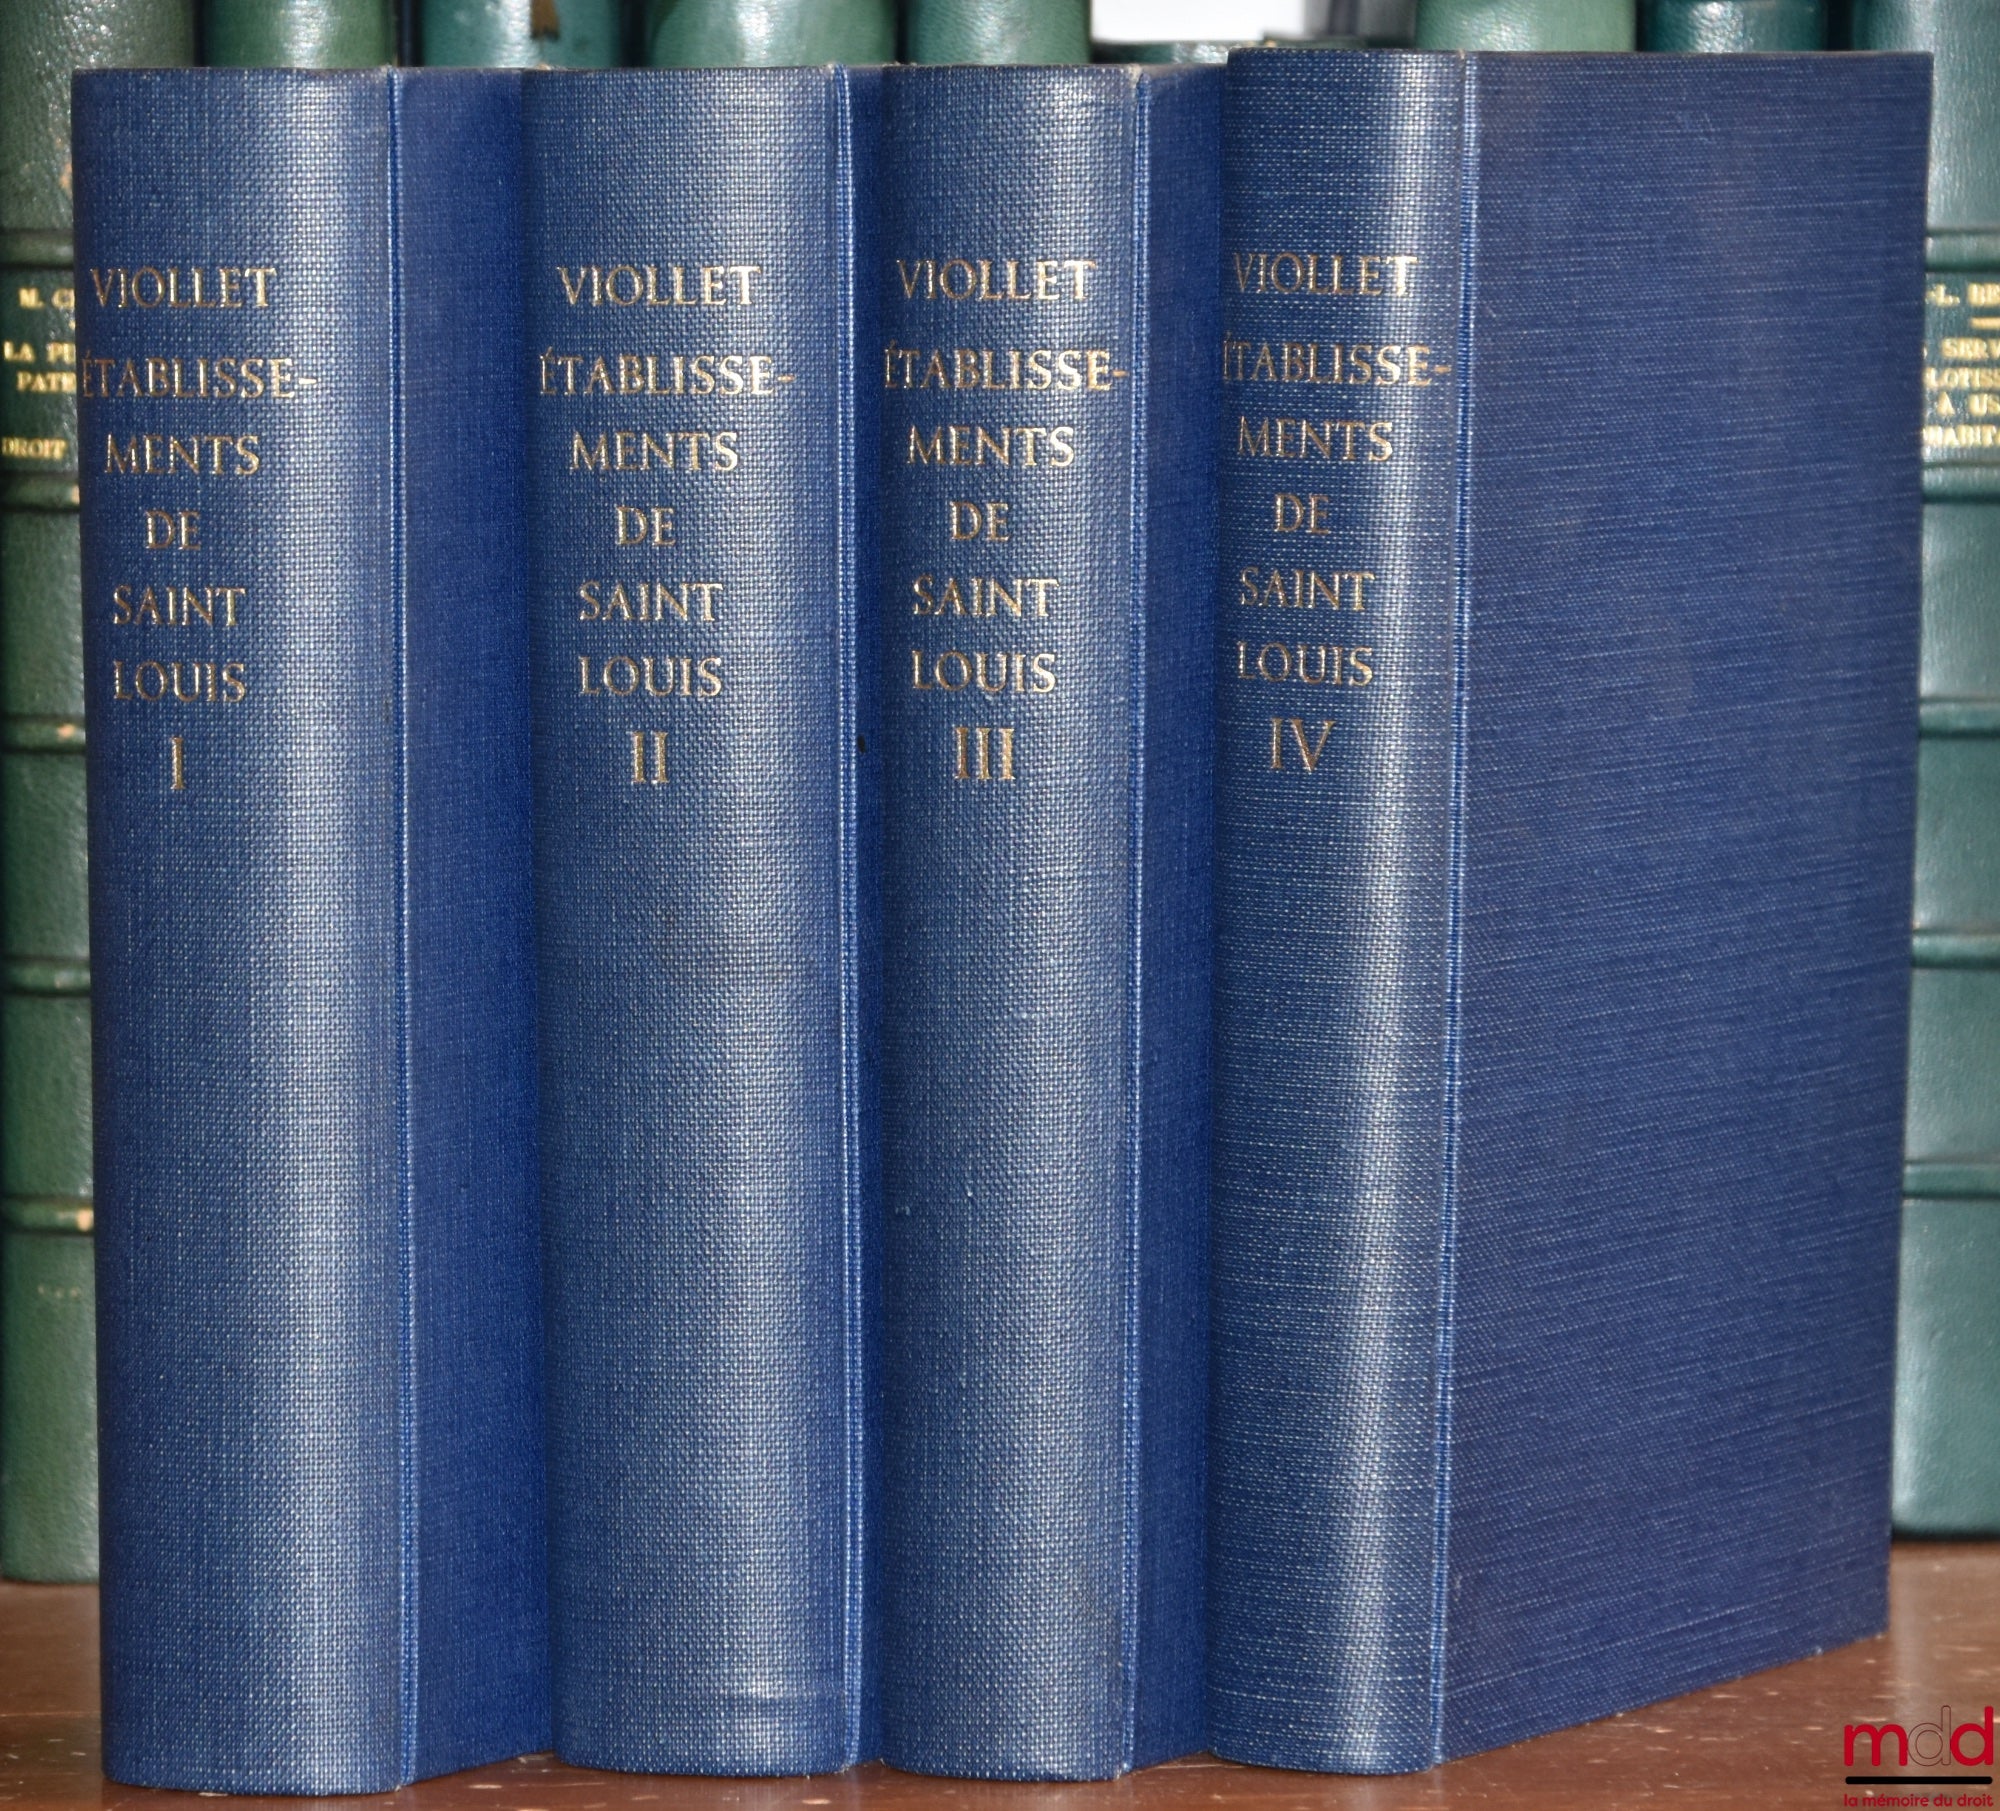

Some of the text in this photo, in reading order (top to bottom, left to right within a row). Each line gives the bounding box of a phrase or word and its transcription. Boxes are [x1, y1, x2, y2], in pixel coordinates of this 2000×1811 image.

[90, 266, 277, 309] VIOLLET
[556, 264, 761, 307] VIOLLET
[896, 258, 1096, 301] VIOLLET
[1234, 252, 1418, 296] VIOLLET
[3, 341, 35, 363] LA
[539, 346, 796, 396] ÉTABLISSE-
[884, 339, 1129, 391] ÉTABLISSE-
[1223, 331, 1452, 387] ÉTABLISSE-
[80, 349, 318, 399] ÉTABLISSE-
[104, 434, 262, 475] MENTS
[569, 430, 739, 473] MENTS
[907, 425, 1075, 468] MENTS
[1238, 415, 1394, 462] MENTS
[145, 509, 201, 550] DE
[615, 505, 675, 546] DE
[950, 500, 1011, 541] DE
[1274, 493, 1330, 534] DE
[112, 584, 246, 626] SAINT
[579, 580, 724, 622] SAINT
[912, 574, 1059, 618] SAINT
[1240, 566, 1375, 611] SAINT
[112, 660, 246, 702] LOUIS
[578, 655, 723, 697] LOUIS
[911, 650, 1057, 693] LOUIS
[1237, 641, 1374, 686] LOUIS
[170, 735, 186, 790] I
[630, 730, 669, 783] II
[954, 726, 1015, 780] III
[1270, 717, 1336, 773] IV
